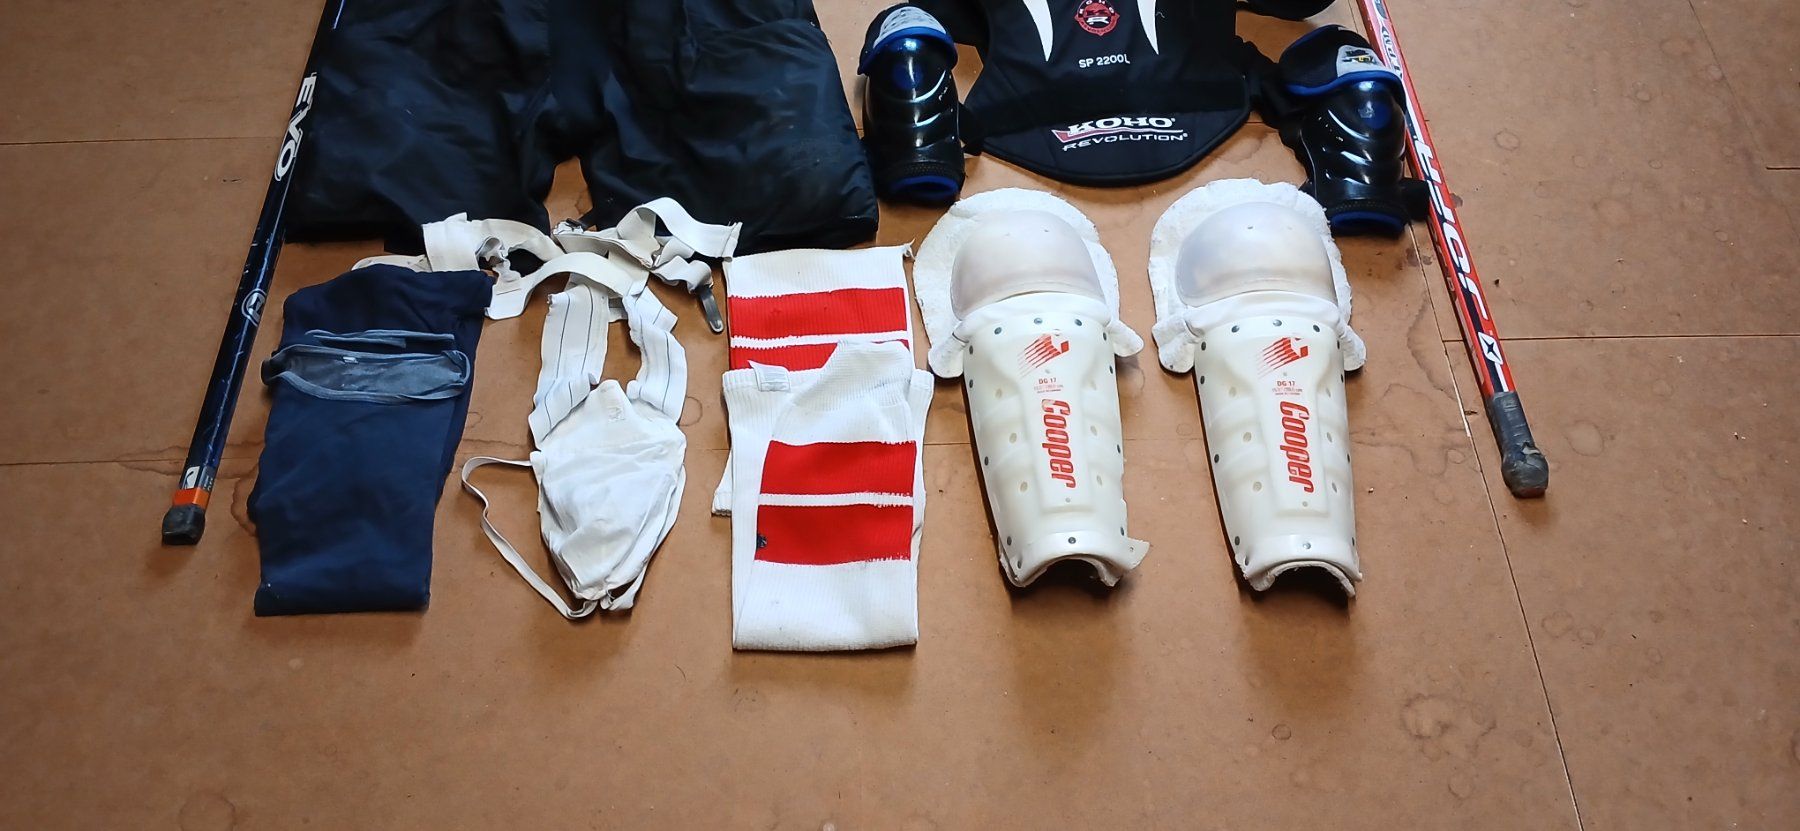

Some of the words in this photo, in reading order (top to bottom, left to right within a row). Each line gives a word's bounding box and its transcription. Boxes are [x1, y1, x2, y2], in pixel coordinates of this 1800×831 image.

[1078, 57, 1094, 69] SP
[275, 72, 317, 181] EVO
[1062, 133, 1184, 151] REVOLUTION
[1067, 116, 1173, 136] KOHO
[1415, 138, 1488, 320] JOFA
[1041, 398, 1077, 489] Cooper
[1279, 400, 1315, 493] Cooper
